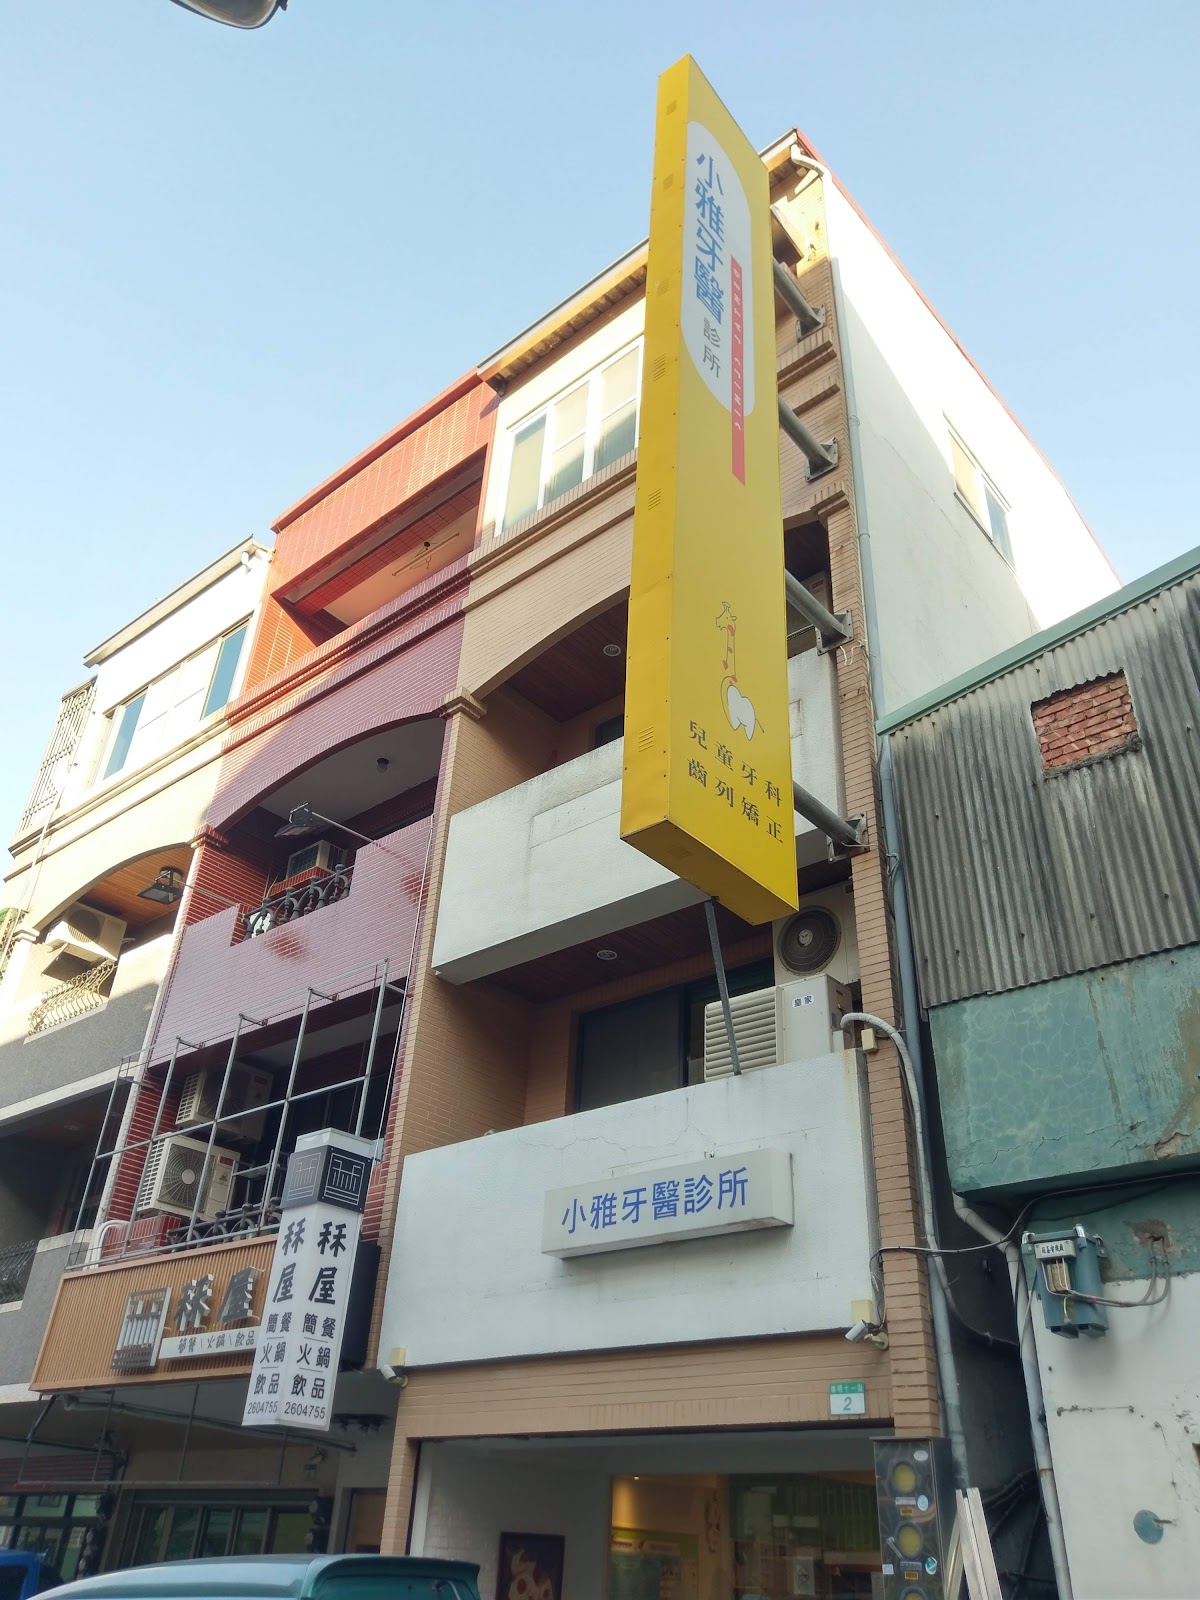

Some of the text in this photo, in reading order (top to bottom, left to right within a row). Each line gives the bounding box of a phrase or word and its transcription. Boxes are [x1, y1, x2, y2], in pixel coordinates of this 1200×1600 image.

[689, 720, 782, 807] 兒童牙科
[687, 758, 783, 844] 齒列矯正
[561, 1166, 749, 1234] 小雅牙醫診所
[266, 1311, 292, 1334] 簡餐
[302, 1312, 336, 1339] 簡餐
[259, 1341, 286, 1364] 火鍋
[296, 1343, 331, 1369] 火鍋
[254, 1373, 280, 1395] 飲品
[291, 1374, 326, 1400] 飲品
[247, 1401, 278, 1415] 2604755
[284, 1401, 326, 1420] 2604755
[843, 1396, 853, 1411] 2
